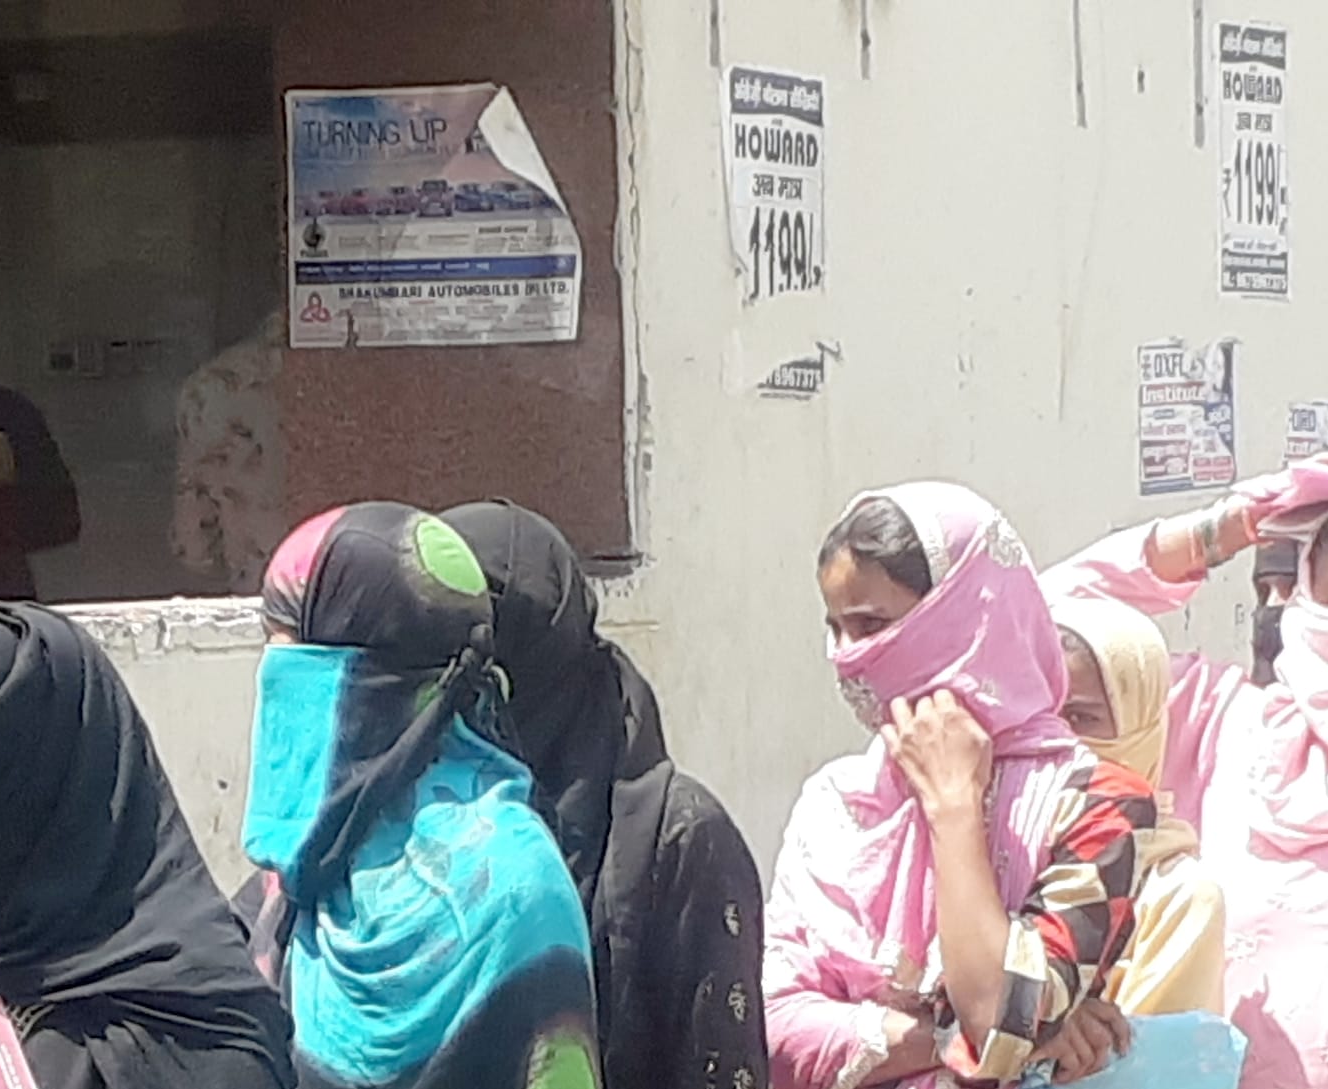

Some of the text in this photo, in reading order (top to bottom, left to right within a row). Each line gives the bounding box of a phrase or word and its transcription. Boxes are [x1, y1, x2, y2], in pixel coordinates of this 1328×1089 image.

[302, 118, 401, 147] TURNING
[409, 117, 448, 145] UP
[734, 122, 819, 168] HOWARD
